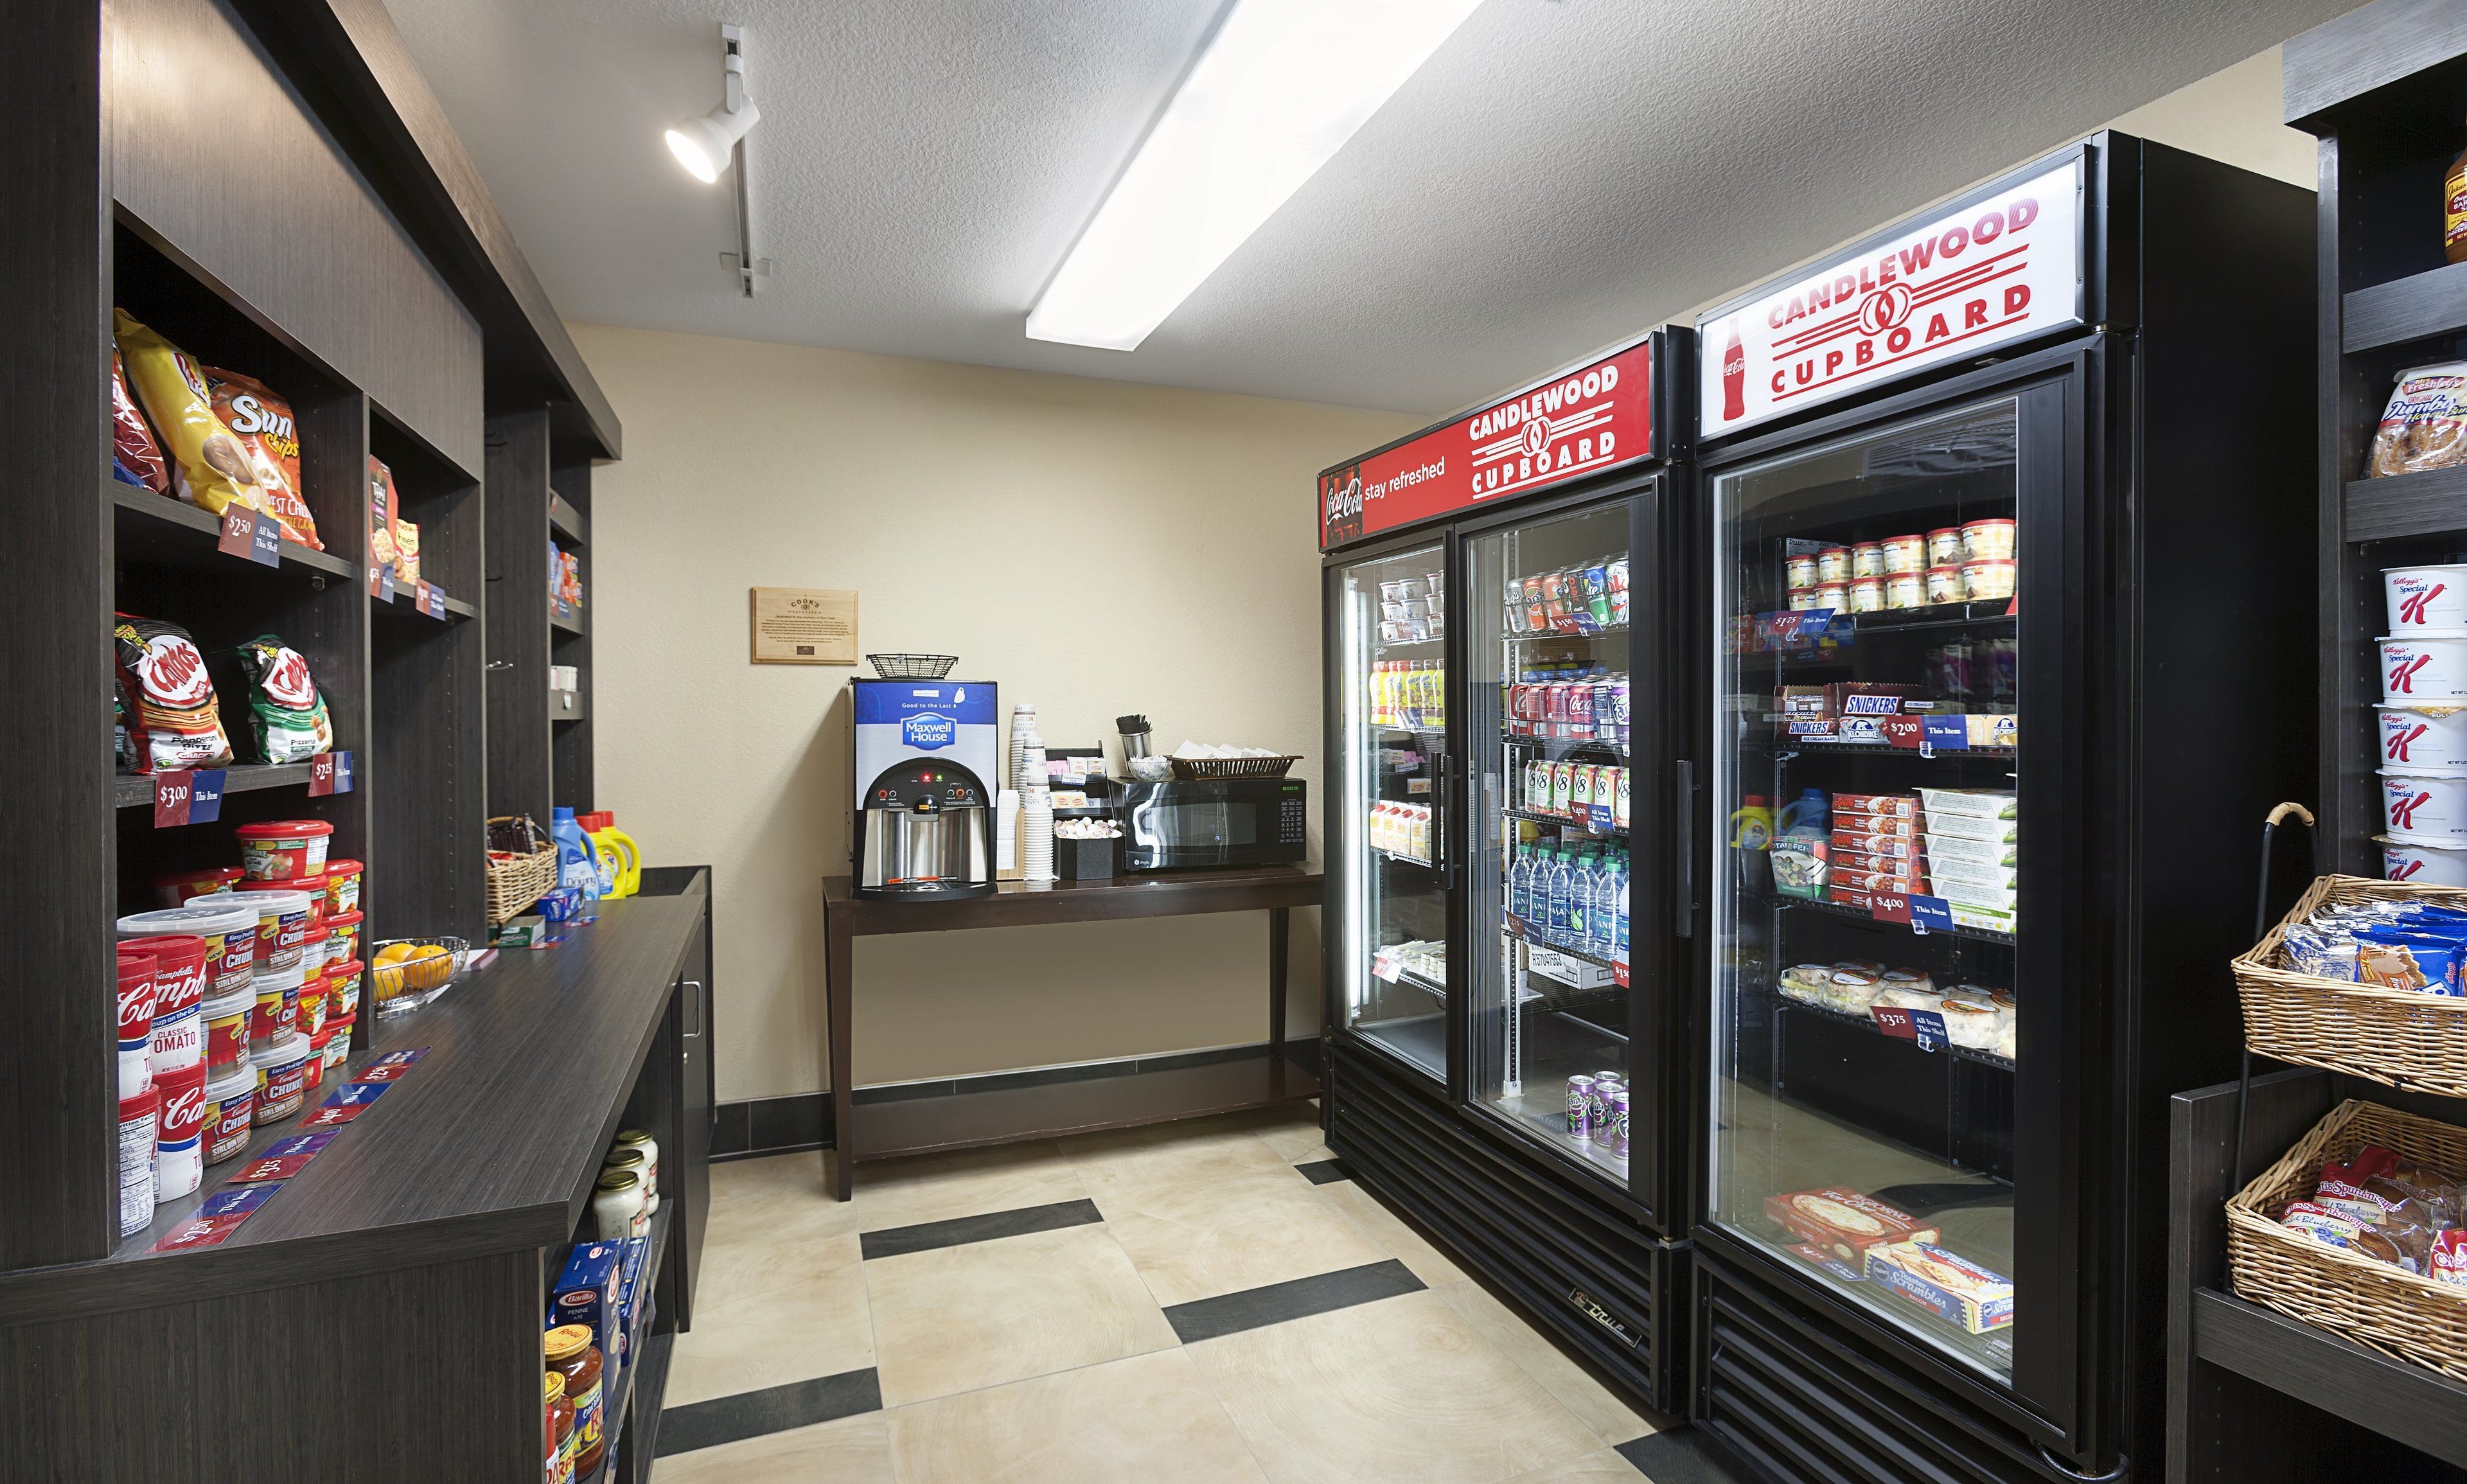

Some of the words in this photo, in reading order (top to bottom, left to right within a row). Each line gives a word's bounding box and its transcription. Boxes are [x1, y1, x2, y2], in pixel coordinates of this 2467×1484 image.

[1767, 197, 2039, 330] CANDLEWOOD
[1771, 284, 2031, 393] CUPBOARD
[2408, 378, 2460, 393] Freshley's
[1469, 365, 1619, 441] CANDLEWOOD
[2408, 394, 2433, 403] ORIGINAL
[2384, 394, 2457, 421] Jumbo
[231, 394, 292, 440] Sun
[264, 432, 299, 458] Chips
[1472, 431, 1616, 493] CUPBOARD
[1365, 479, 1386, 501] stay
[1388, 456, 1446, 493] refreshed
[1326, 477, 1363, 526] Coca-Cola
[256, 538, 266, 549] This
[267, 541, 278, 552] Shelf
[2400, 585, 2428, 594] Special
[791, 599, 820, 608] COOK'S
[2400, 583, 2445, 624] K
[1557, 619, 1573, 628] $150
[1775, 617, 1798, 627] $175
[2389, 655, 2414, 664] Special
[2389, 654, 2430, 694] K
[1848, 696, 1897, 713] SNICKERS
[2381, 714, 2403, 723] Kellogg's
[906, 722, 951, 733] Maxwell
[1790, 722, 1828, 733] SNICKERS
[1891, 723, 1917, 736] $200
[2386, 723, 2411, 732] Special
[172, 736, 217, 744] Pepperoni
[911, 732, 948, 742] House
[1847, 729, 1879, 742] KLONDIKE
[2387, 723, 2427, 762] K
[316, 763, 332, 780] $225
[1537, 770, 1548, 788] V8
[1555, 771, 1568, 791] V8
[1575, 773, 1586, 793] V8
[1596, 775, 1606, 795] V8
[2385, 781, 2405, 789] Kellogg's
[1617, 777, 1629, 798] V8
[2389, 790, 2414, 798] Special
[161, 786, 188, 808] $300
[195, 791, 206, 801] This
[207, 791, 218, 800] Item
[1572, 806, 1586, 817] $400
[2391, 791, 2430, 829] K
[2387, 856, 2408, 865] Special
[566, 878, 596, 887] Downy
[1877, 897, 1904, 911] $400
[1914, 905, 1931, 914] This
[1931, 907, 1947, 916] Item
[264, 928, 278, 937] NEW!
[208, 950, 223, 960] NEW!
[156, 966, 195, 979] Campbell's
[215, 975, 241, 989] SIRLOIN
[269, 1005, 281, 1015] NEW!
[152, 1018, 166, 1027] oup
[176, 1011, 187, 1020] the
[1880, 1013, 1906, 1027] $375
[1926, 1019, 1941, 1027] Items
[158, 1027, 187, 1039] CLASSIC
[1931, 1028, 1945, 1036] Shelf
[152, 1032, 196, 1053] OMATO
[225, 1099, 238, 1107] Easy
[259, 1104, 286, 1119] SIRLOIN
[204, 1117, 219, 1127] NEW!
[212, 1139, 236, 1156] SIRLOIN
[249, 1160, 281, 1179] $325
[218, 1199, 239, 1213] This
[2335, 1203, 2381, 1220] Blueberry
[175, 1219, 214, 1243] $250
[2302, 1215, 2353, 1234] Blueberry
[1900, 1270, 1927, 1290] Toaster
[1890, 1271, 1947, 1307] Scrambles
[568, 1293, 594, 1303] Barilla
[1909, 1293, 1927, 1307] BACON
